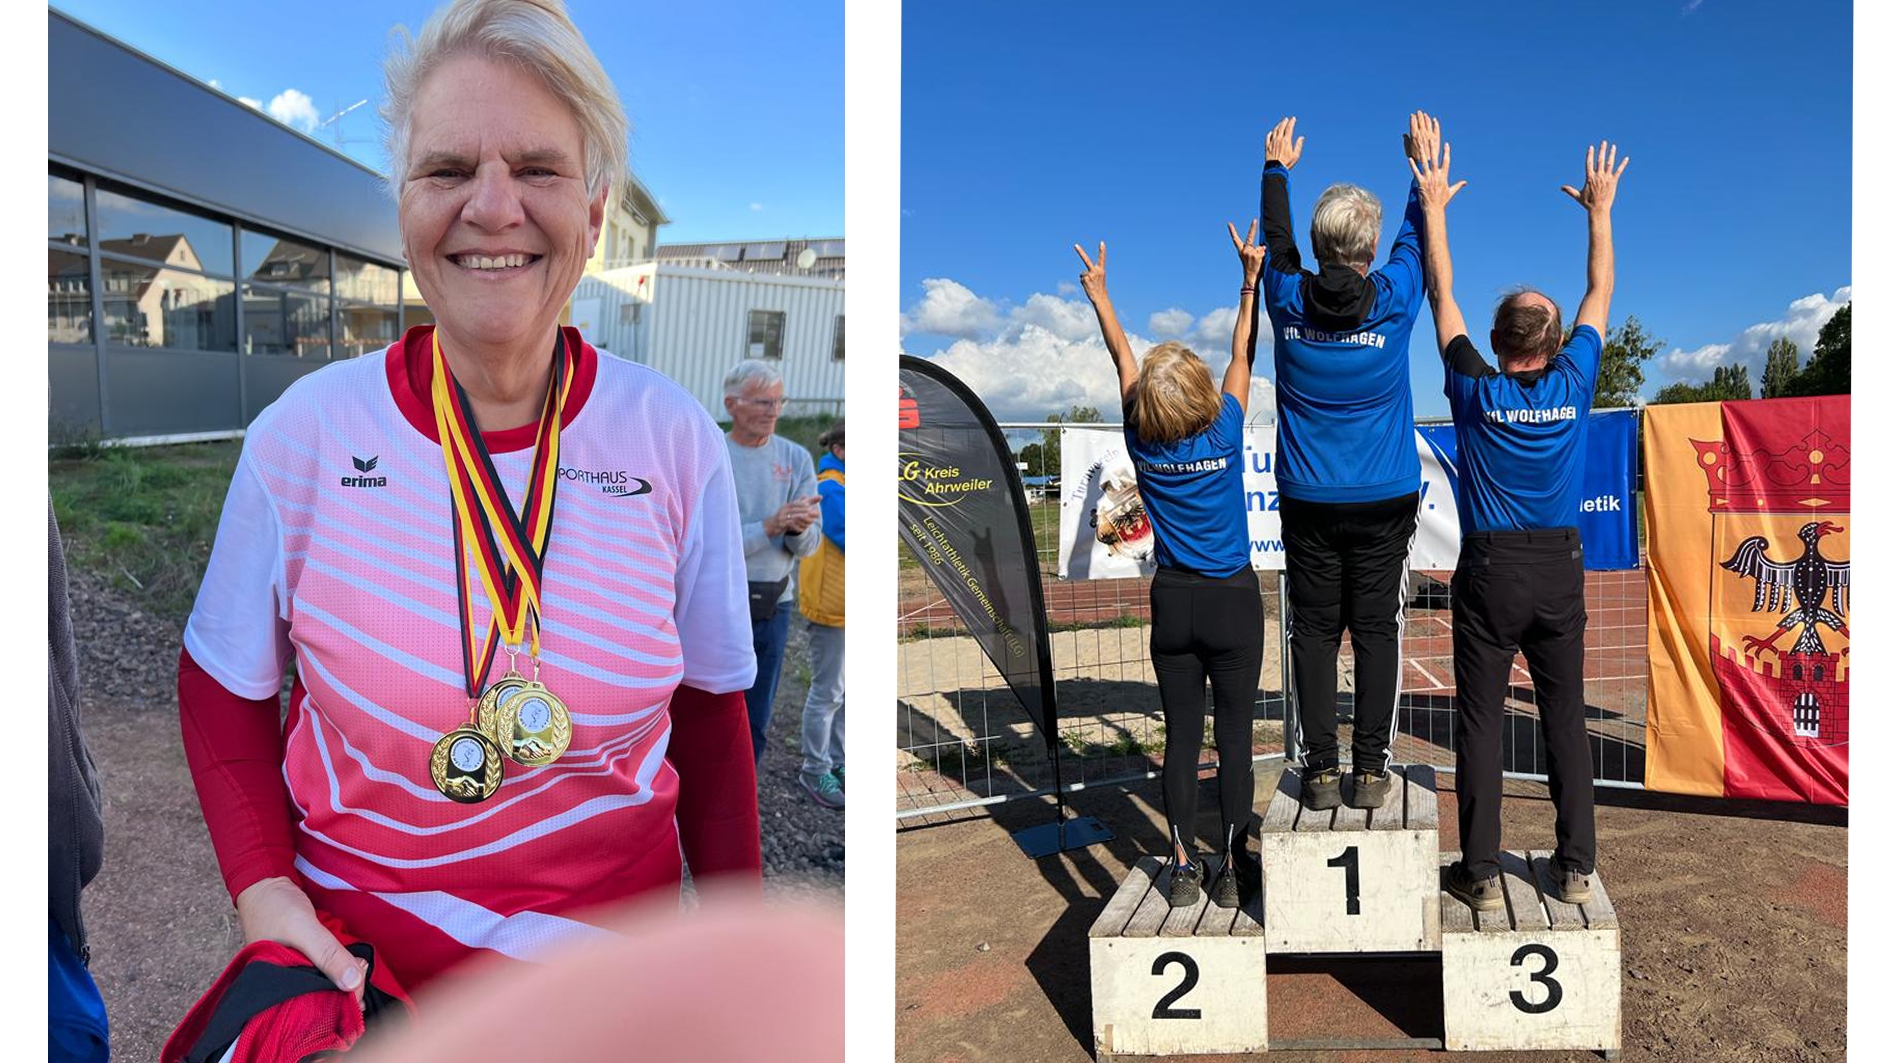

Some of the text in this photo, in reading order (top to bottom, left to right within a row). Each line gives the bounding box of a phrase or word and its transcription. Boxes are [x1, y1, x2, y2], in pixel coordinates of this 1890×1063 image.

[1304, 327, 1386, 349] WOLFHAGEN
[341, 475, 386, 487] erima
[558, 467, 627, 484] PORTHAUS
[925, 466, 959, 479] Kreis
[602, 485, 627, 493] KASSEL
[924, 479, 993, 494] Ahrweiler
[910, 523, 944, 566] seit 1986
[923, 516, 970, 579] Leichtathletik
[967, 577, 1012, 638] Gemeinschaft
[1327, 846, 1360, 915] 1
[1151, 951, 1201, 1020] 2
[1509, 943, 1563, 1014] 3
